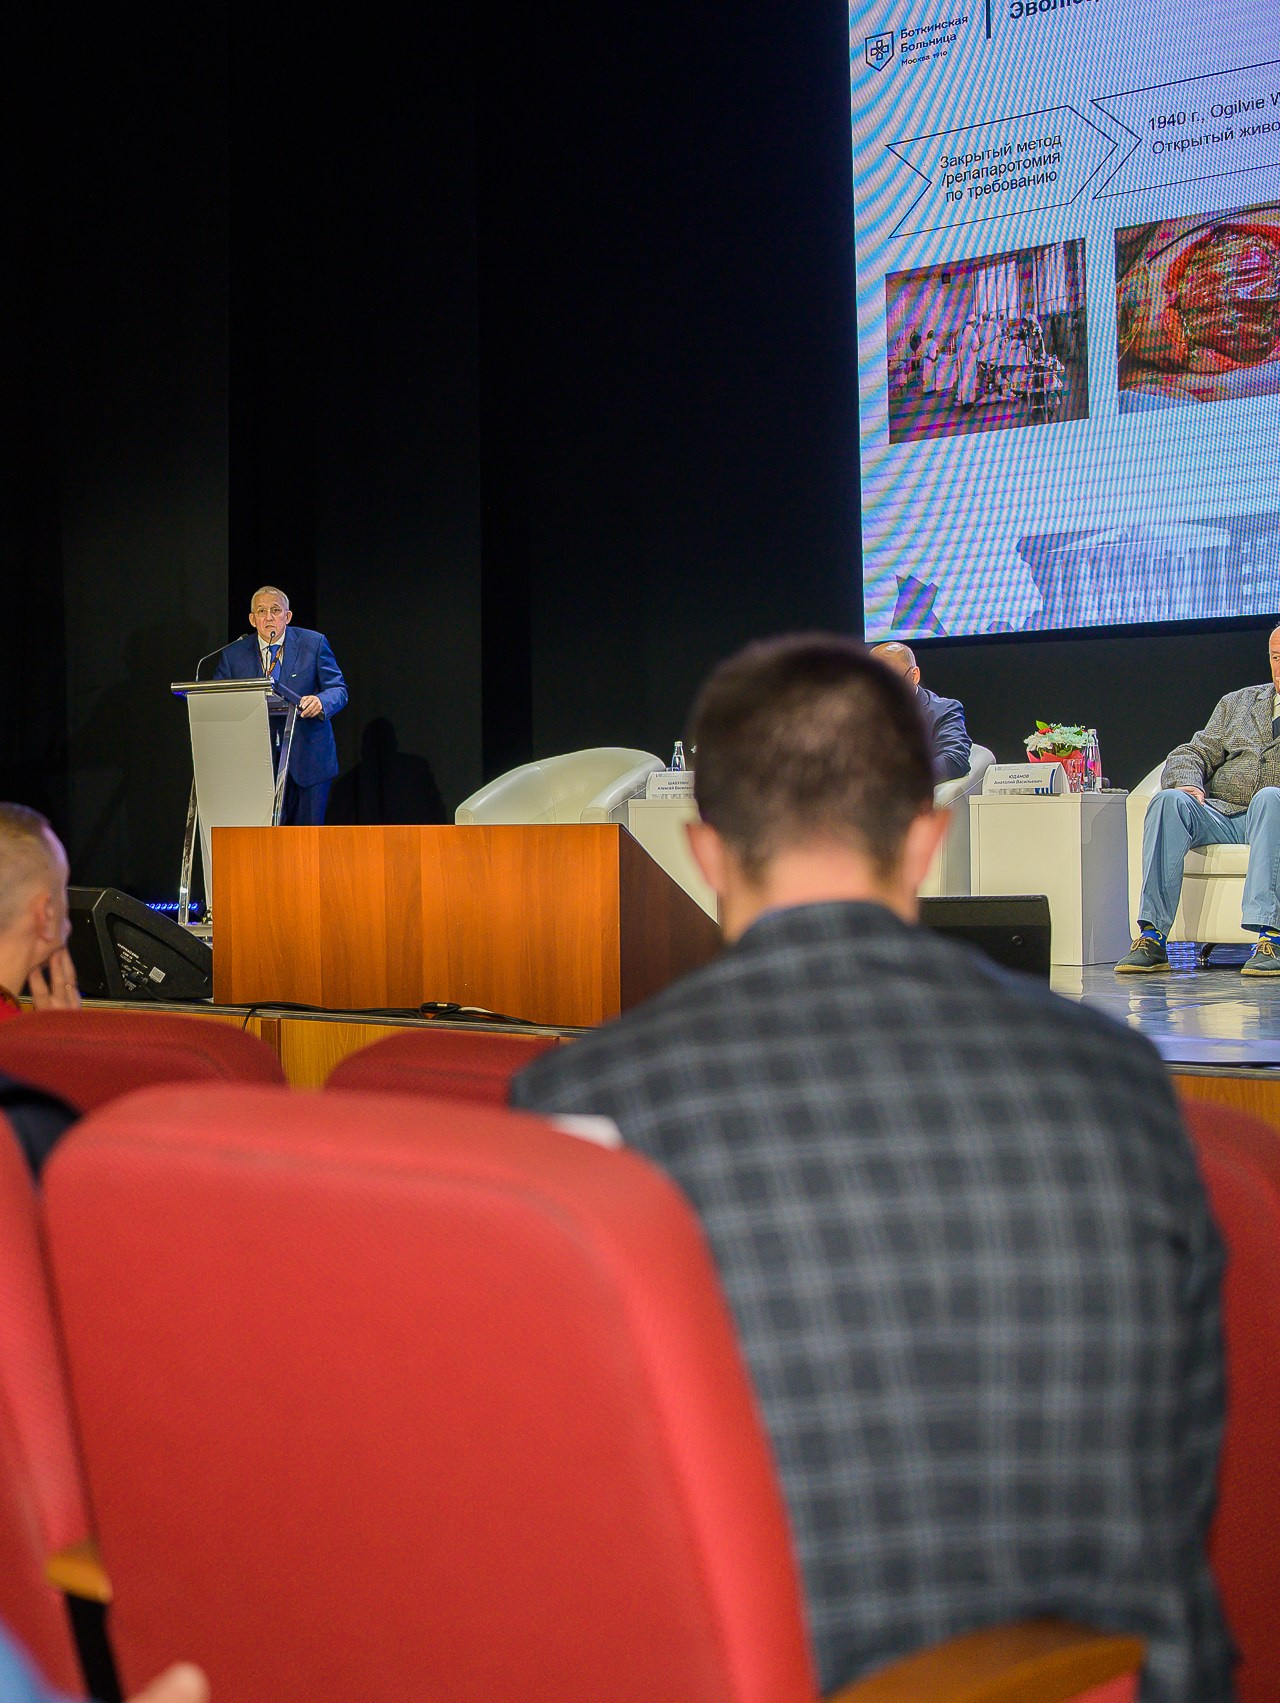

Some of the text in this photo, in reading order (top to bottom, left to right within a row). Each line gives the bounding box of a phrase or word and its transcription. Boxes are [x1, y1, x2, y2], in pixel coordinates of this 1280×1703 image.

[900, 16, 968, 39] Боткинская
[900, 33, 957, 53] Больница
[901, 54, 931, 66] Москва
[1148, 111, 1187, 131] 1940
[1210, 97, 1265, 119] Ogilvie
[940, 135, 1062, 169] Закрытый метод
[1152, 127, 1235, 155] Открытый
[941, 152, 1061, 188] /релапаротомия
[945, 171, 1057, 203] по требованию
